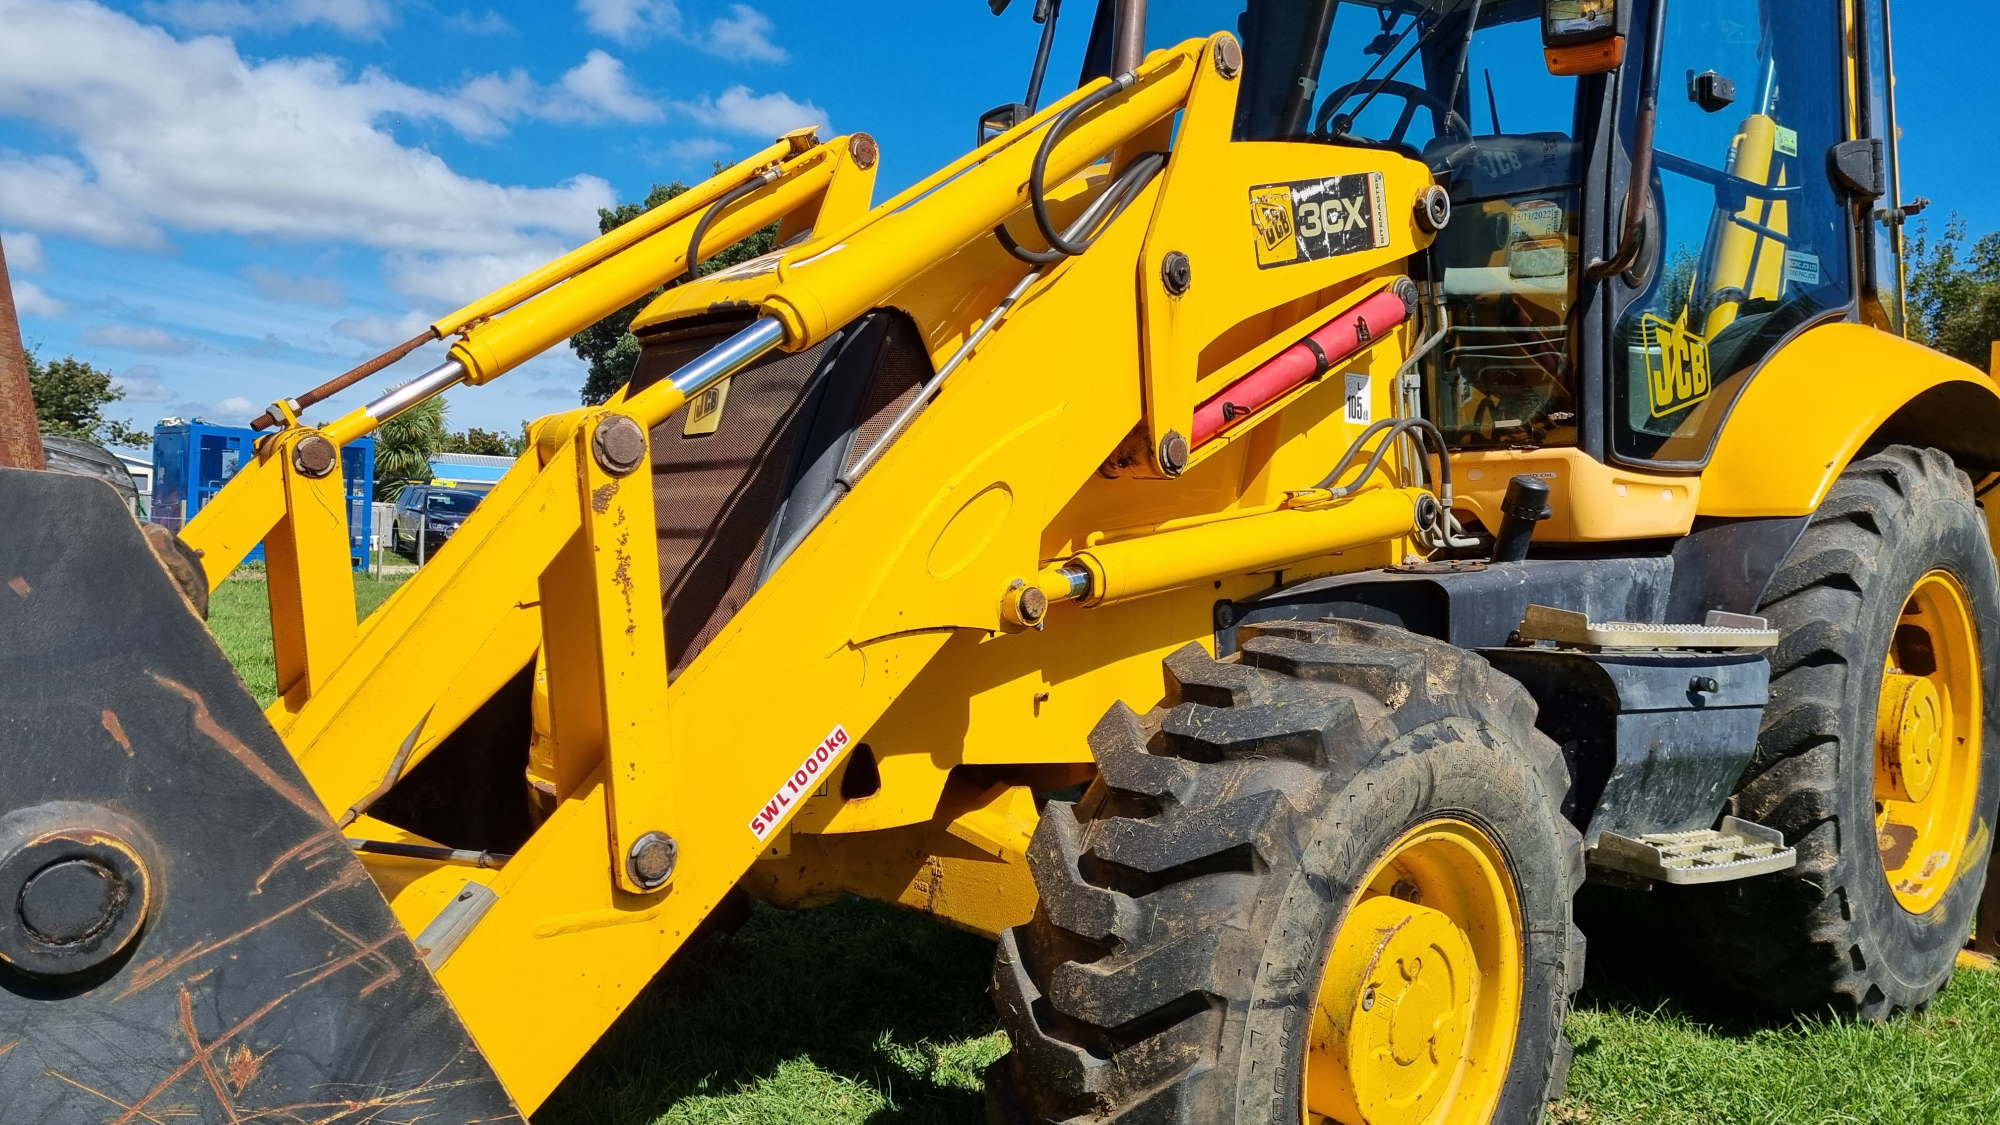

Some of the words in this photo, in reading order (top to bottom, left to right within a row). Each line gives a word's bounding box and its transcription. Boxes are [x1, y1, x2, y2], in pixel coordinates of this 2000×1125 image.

[1482, 151, 1522, 178] JCB
[1298, 195, 1368, 238] 3CX
[1653, 327, 1707, 407] JCB
[1347, 394, 1363, 420] 105
[751, 793, 790, 835] SWL
[787, 728, 848, 794] 1000kg
